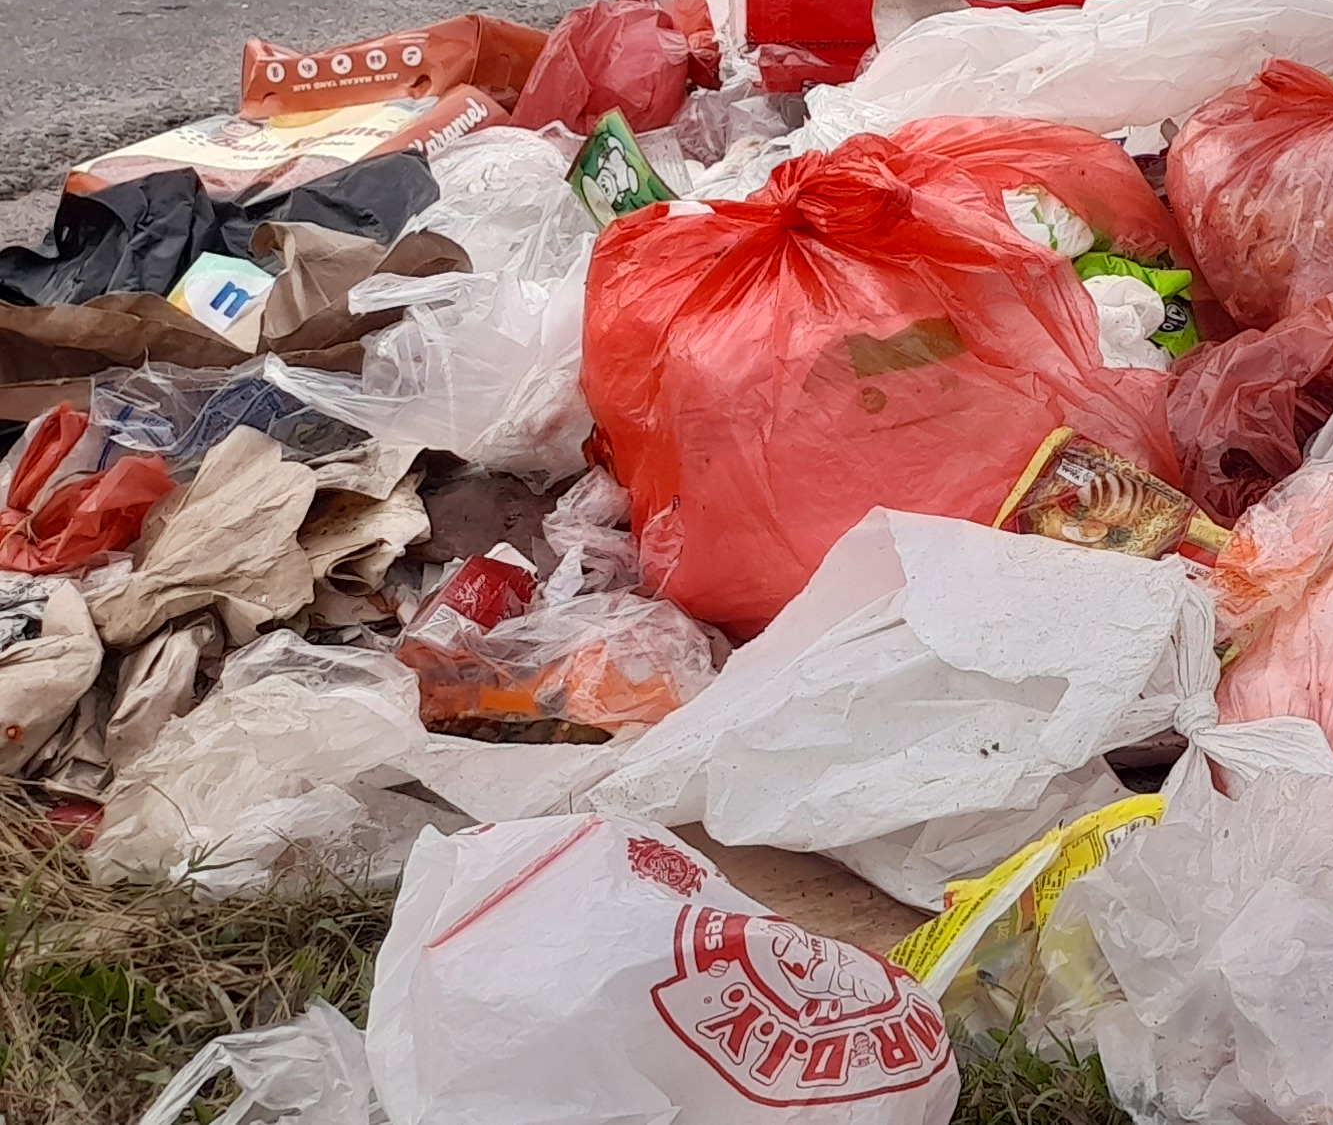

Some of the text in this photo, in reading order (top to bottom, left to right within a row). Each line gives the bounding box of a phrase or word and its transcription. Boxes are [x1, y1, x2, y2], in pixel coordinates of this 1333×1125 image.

[313, 79, 337, 90] YANG
[338, 75, 372, 86] MAKAN
[292, 82, 312, 92] BAIK
